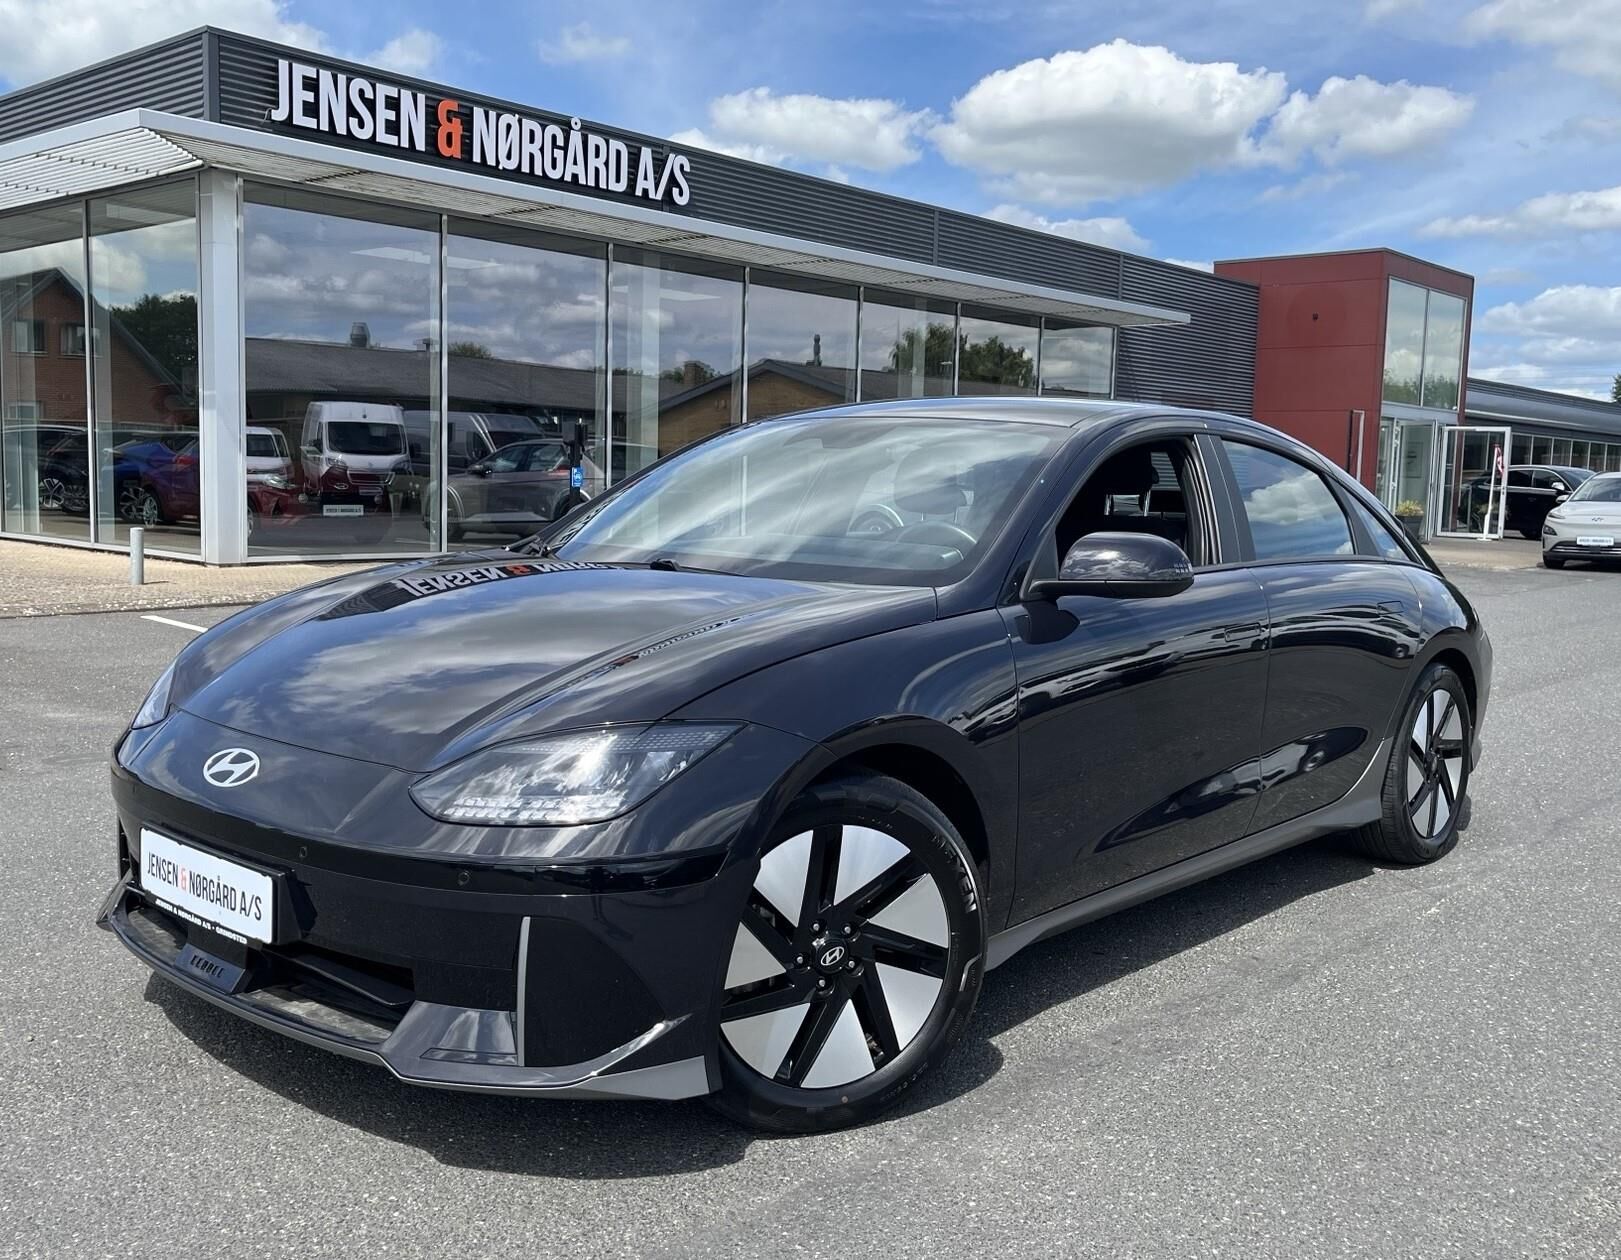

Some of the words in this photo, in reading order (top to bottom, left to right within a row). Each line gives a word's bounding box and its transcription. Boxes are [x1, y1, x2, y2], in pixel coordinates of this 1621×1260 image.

[271, 59, 426, 152] JENSEN
[437, 99, 464, 159] &
[472, 106, 628, 193] NØRGÅRD
[635, 146, 691, 206] A/S
[148, 851, 179, 888] JENSEN
[180, 865, 188, 891] &
[189, 870, 237, 912] NØRGÅRD
[240, 891, 262, 921] A/S
